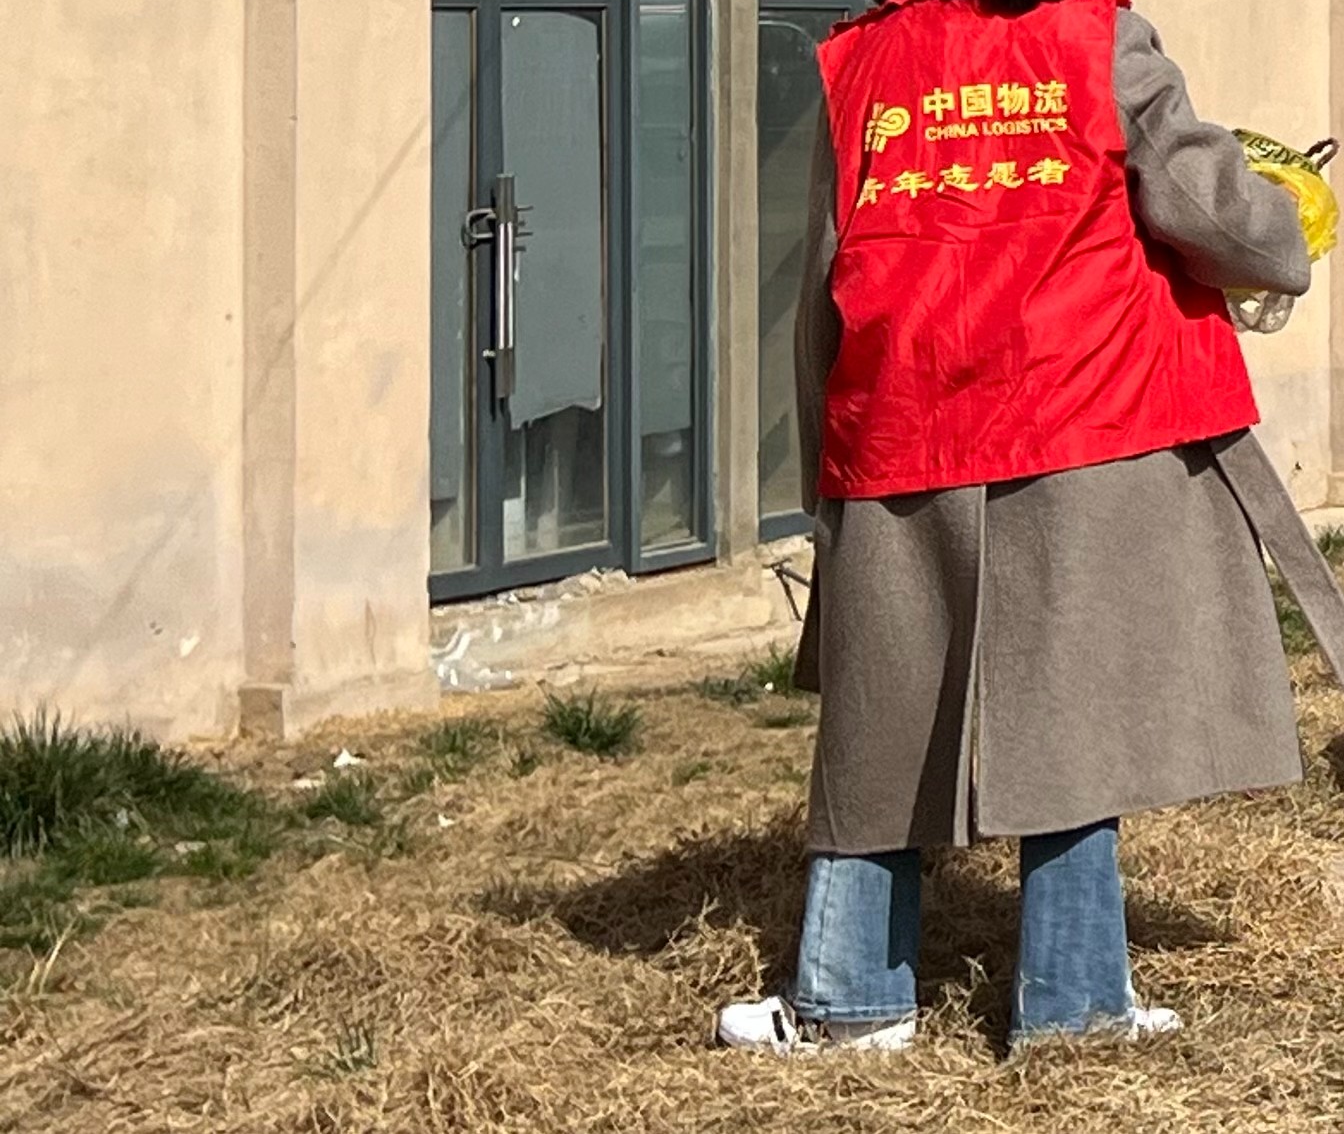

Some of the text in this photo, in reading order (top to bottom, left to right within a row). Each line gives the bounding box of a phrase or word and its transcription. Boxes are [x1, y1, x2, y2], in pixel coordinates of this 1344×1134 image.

[923, 80, 1068, 122] 中国物流
[925, 117, 1068, 141] CHINA LOGISTICS
